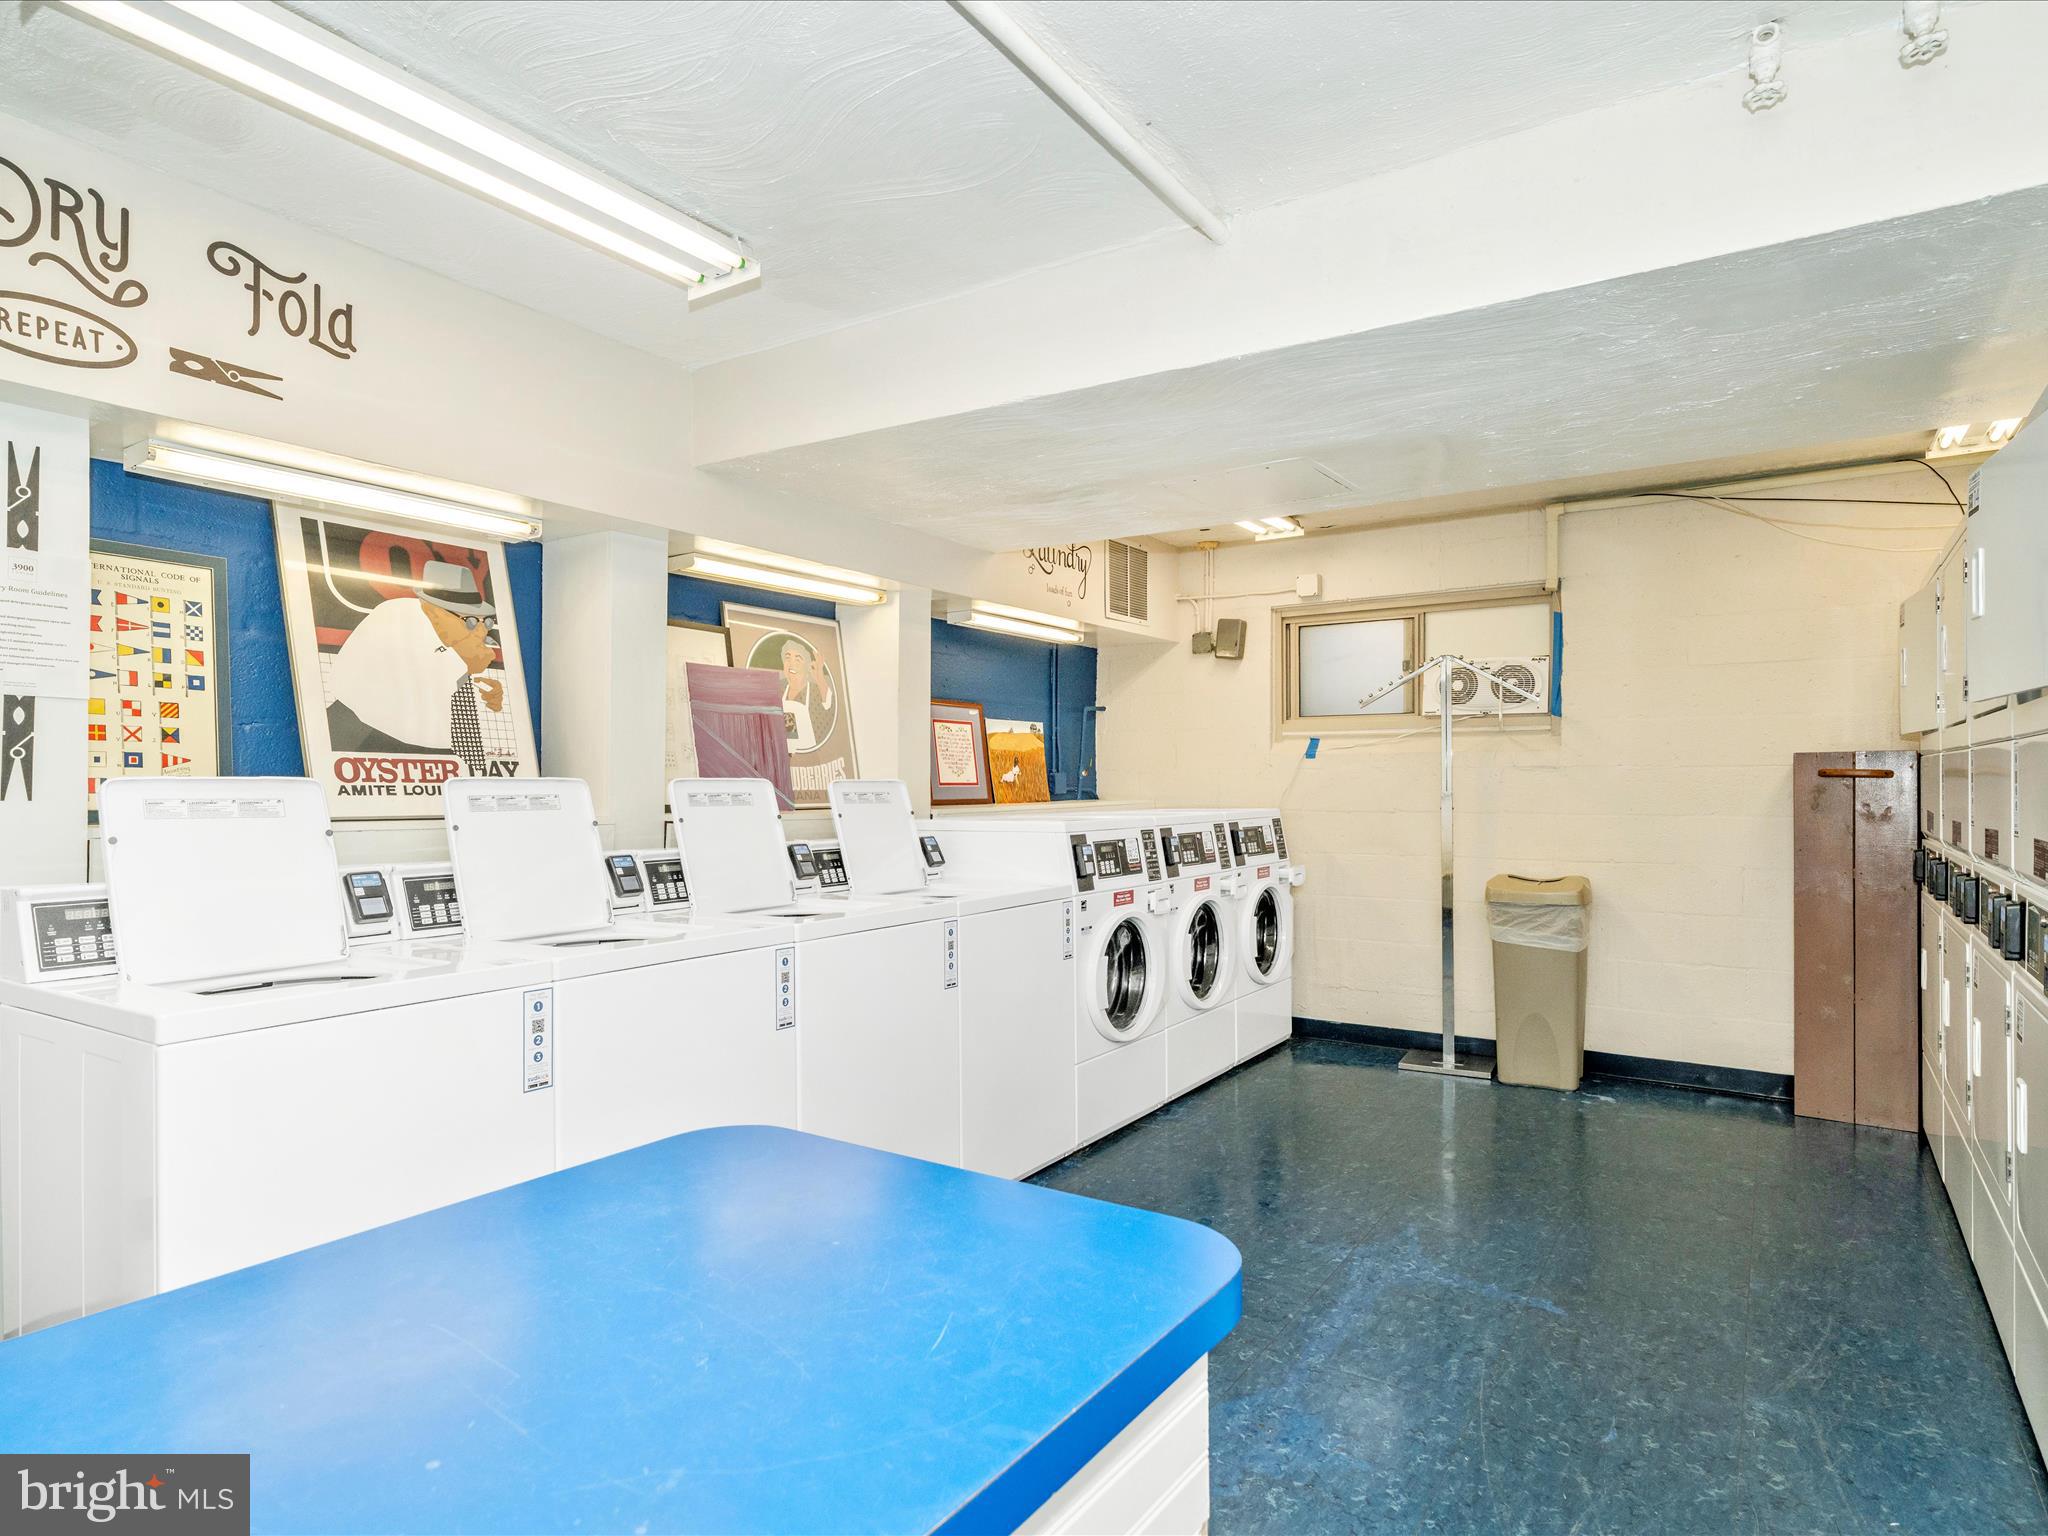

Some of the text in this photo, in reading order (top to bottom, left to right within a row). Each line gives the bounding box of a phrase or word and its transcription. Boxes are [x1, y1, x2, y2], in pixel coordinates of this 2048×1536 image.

[207, 241, 357, 359] Fold
[13, 563, 34, 573] 3900
[120, 573, 160, 585] SIGNALS
[161, 572, 186, 582] CODE
[189, 576, 201, 584] OF
[8, 585, 30, 594] Room
[30, 588, 68, 599] Guidelines
[333, 757, 460, 784] OYSTER
[337, 784, 442, 796] AMITE LOUI
[797, 790, 821, 801] ANA
